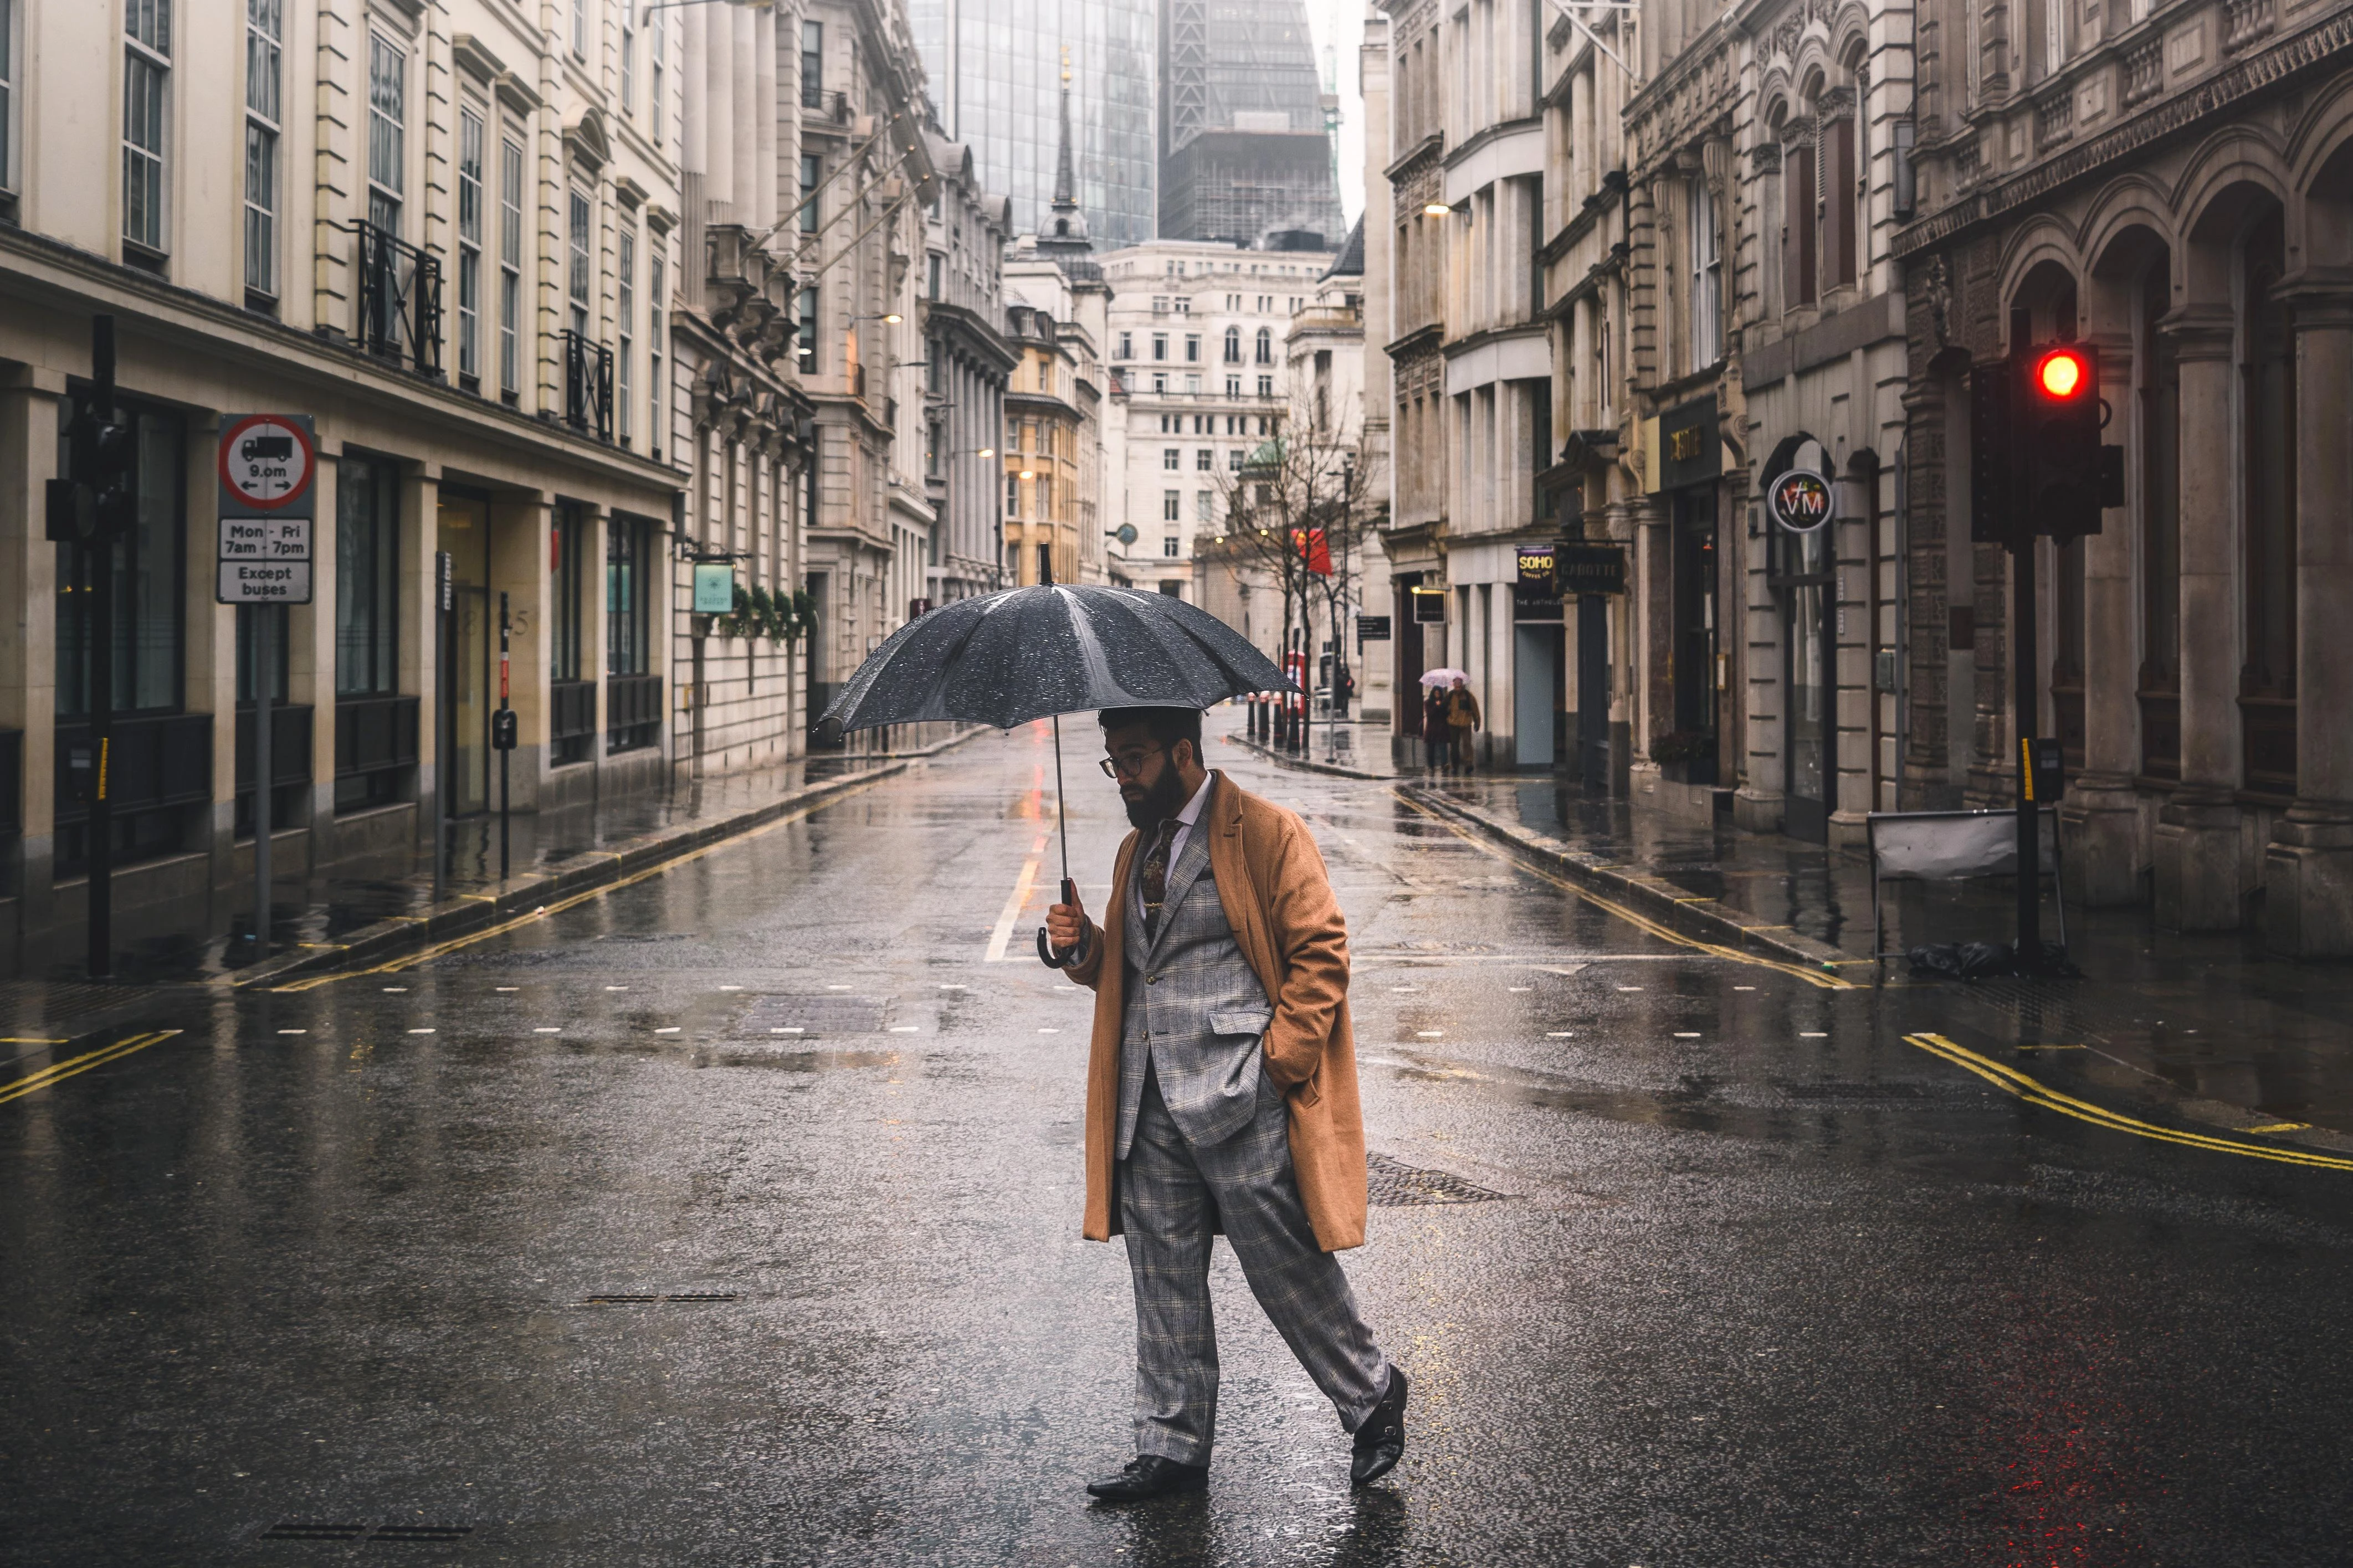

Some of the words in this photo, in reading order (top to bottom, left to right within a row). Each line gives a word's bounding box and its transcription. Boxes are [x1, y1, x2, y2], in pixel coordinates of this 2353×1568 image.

[231, 526, 264, 538] Mon
[282, 526, 300, 538] Fri
[226, 541, 256, 553] 7am
[273, 541, 304, 556] 7pm
[1519, 556, 1553, 569] SOHO
[239, 567, 291, 582] Except
[242, 583, 286, 595] buses
